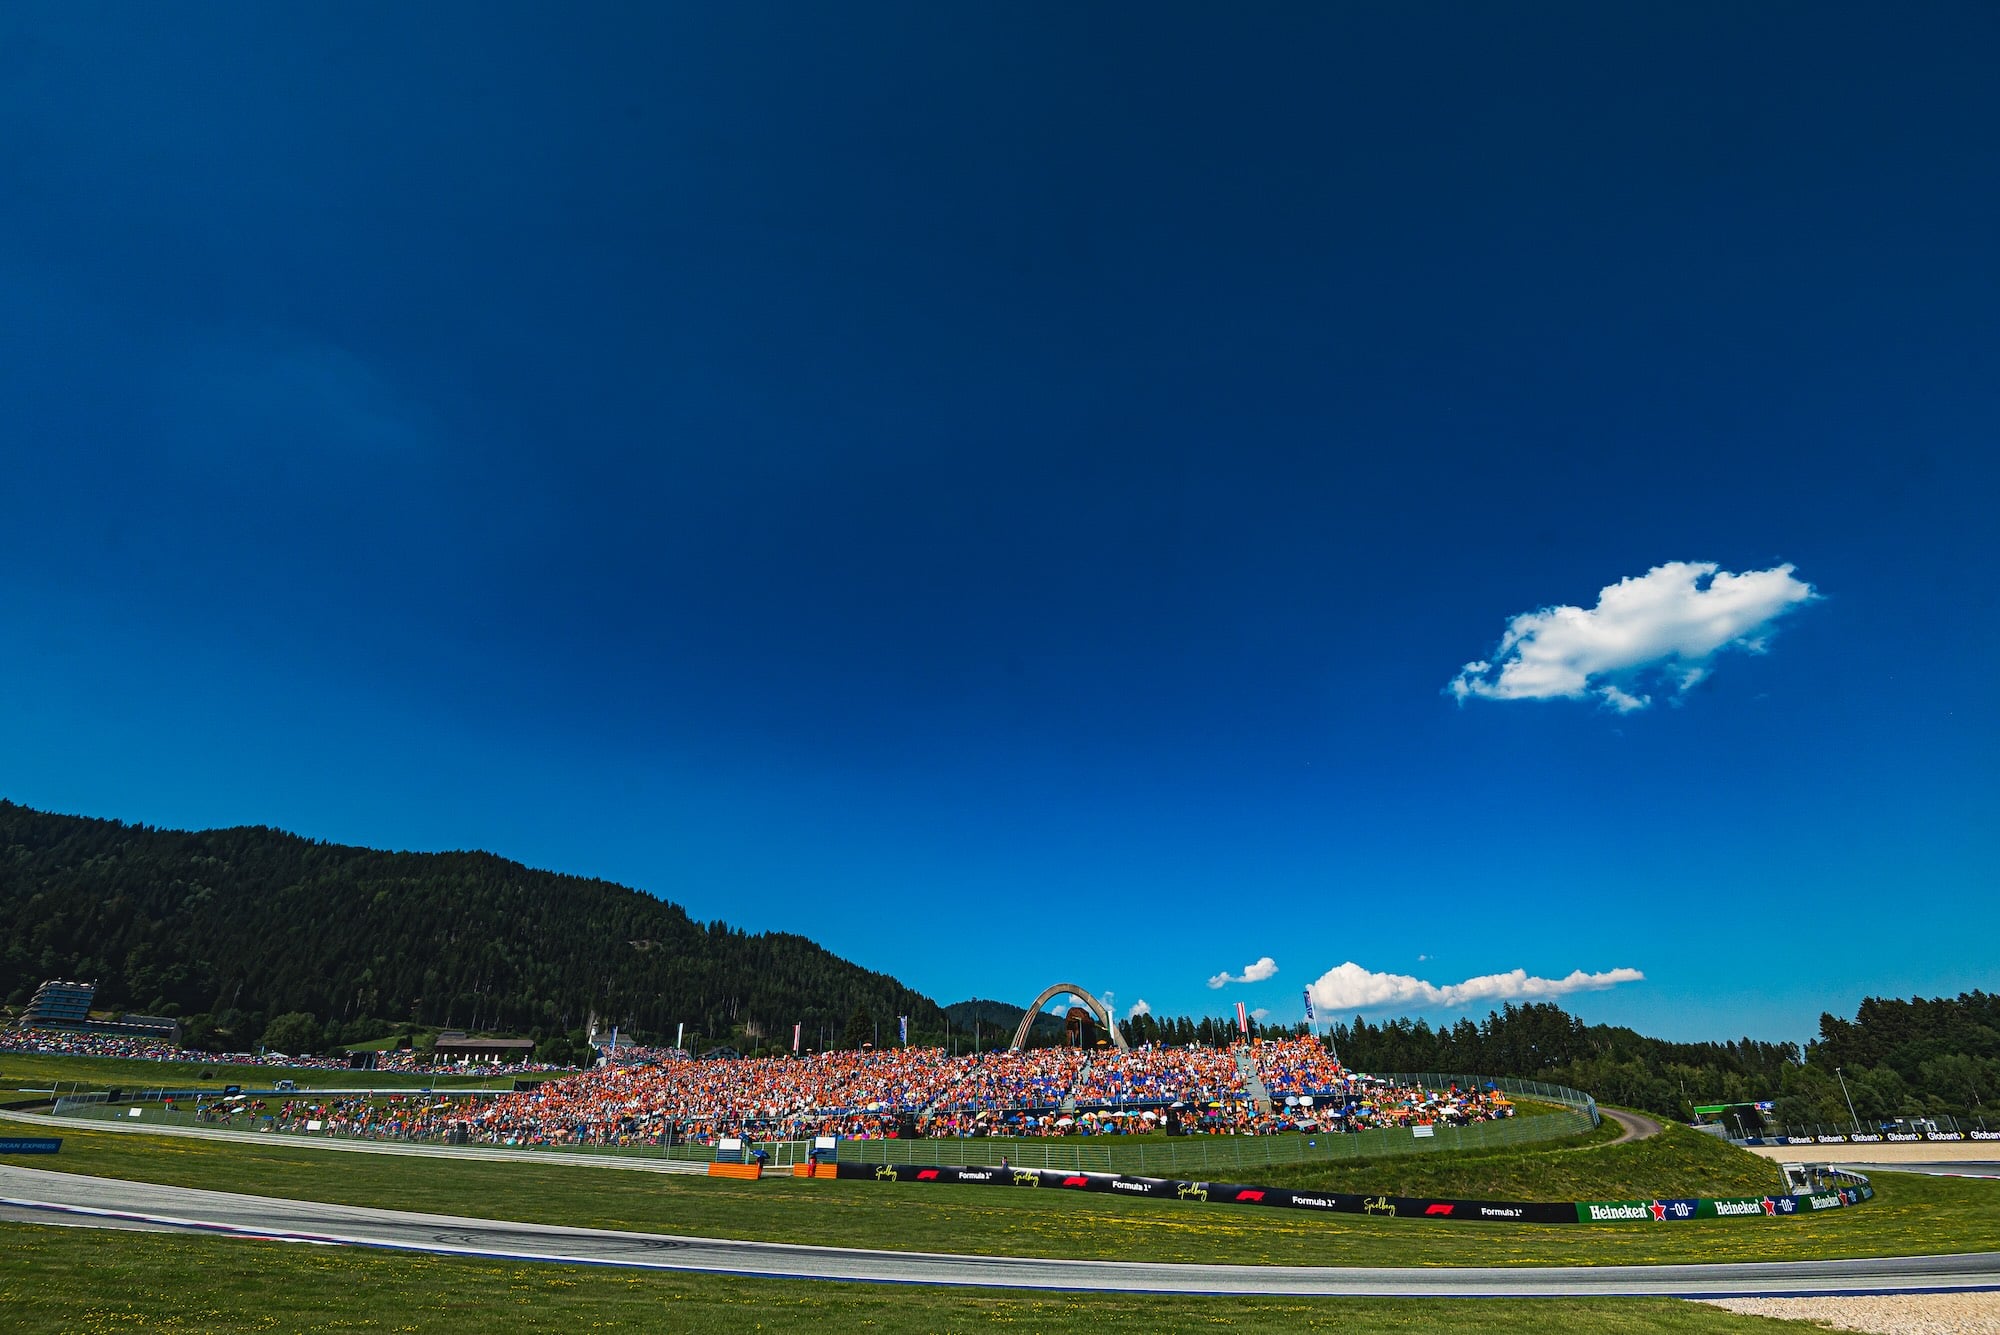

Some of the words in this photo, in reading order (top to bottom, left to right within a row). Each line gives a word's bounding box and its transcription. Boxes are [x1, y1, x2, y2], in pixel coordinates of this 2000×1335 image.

[1112, 1181, 1143, 1191] Formula
[1292, 1196, 1326, 1206] Formula
[1810, 1194, 1841, 1209] Heineken
[1481, 1207, 1514, 1216] Formula
[1589, 1204, 1648, 1219] Heineken
[1714, 1200, 1761, 1215] Heineken
